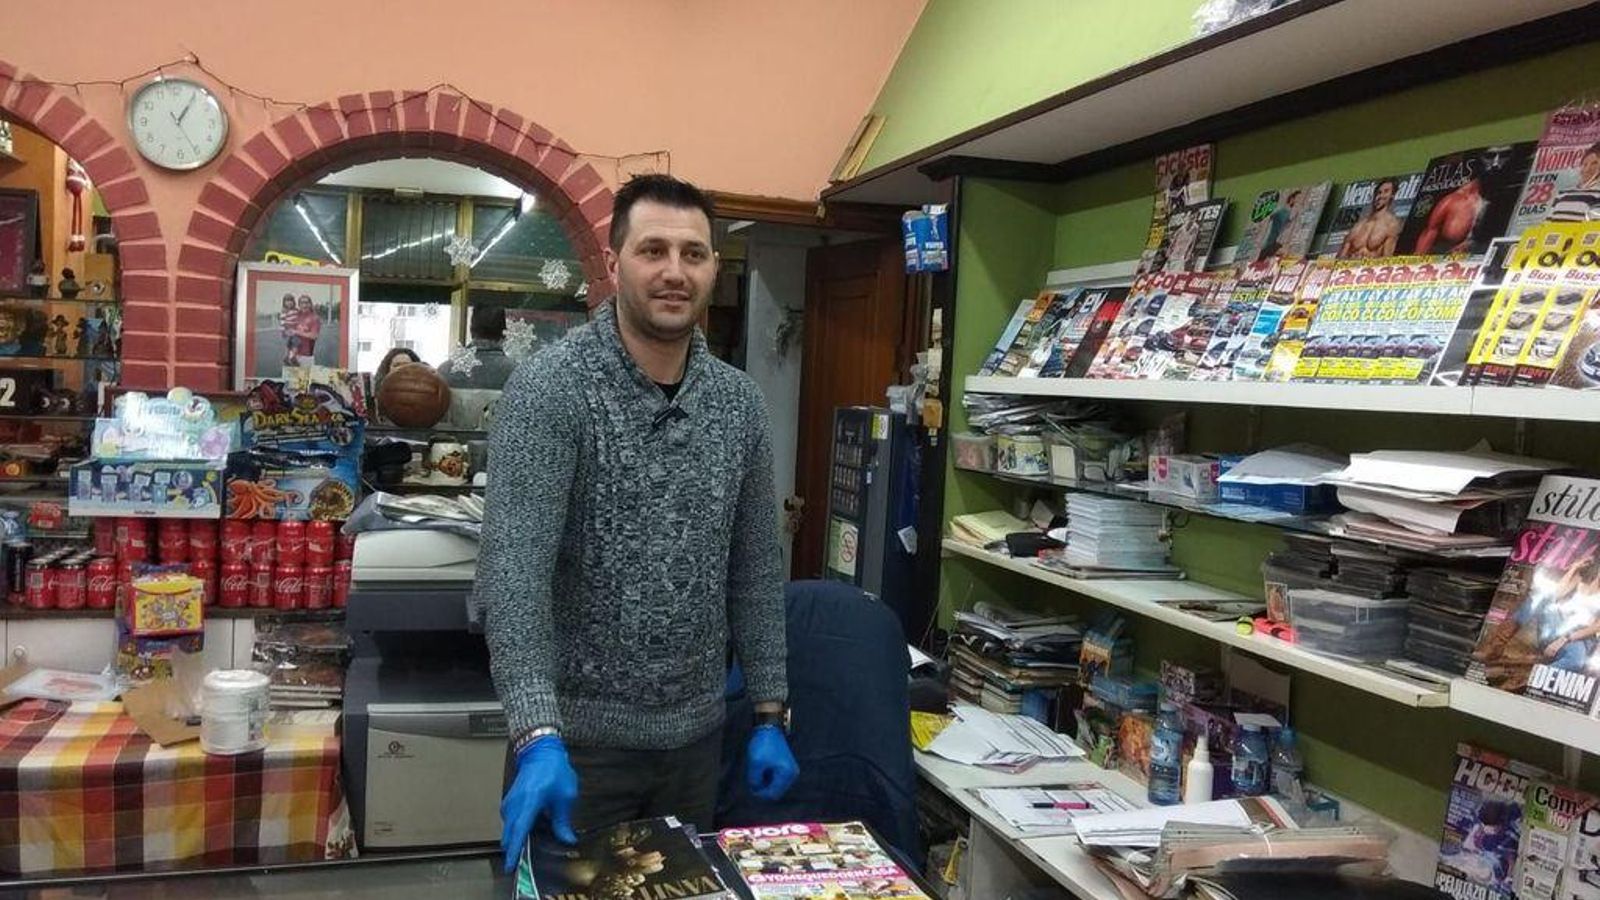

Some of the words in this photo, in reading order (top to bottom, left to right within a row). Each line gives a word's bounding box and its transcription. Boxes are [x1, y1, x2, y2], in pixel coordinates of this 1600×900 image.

[1427, 158, 1475, 185] ATLAS
[1523, 182, 1554, 205] 28
[1529, 663, 1595, 702] DENIM
[724, 824, 810, 838] cuore
